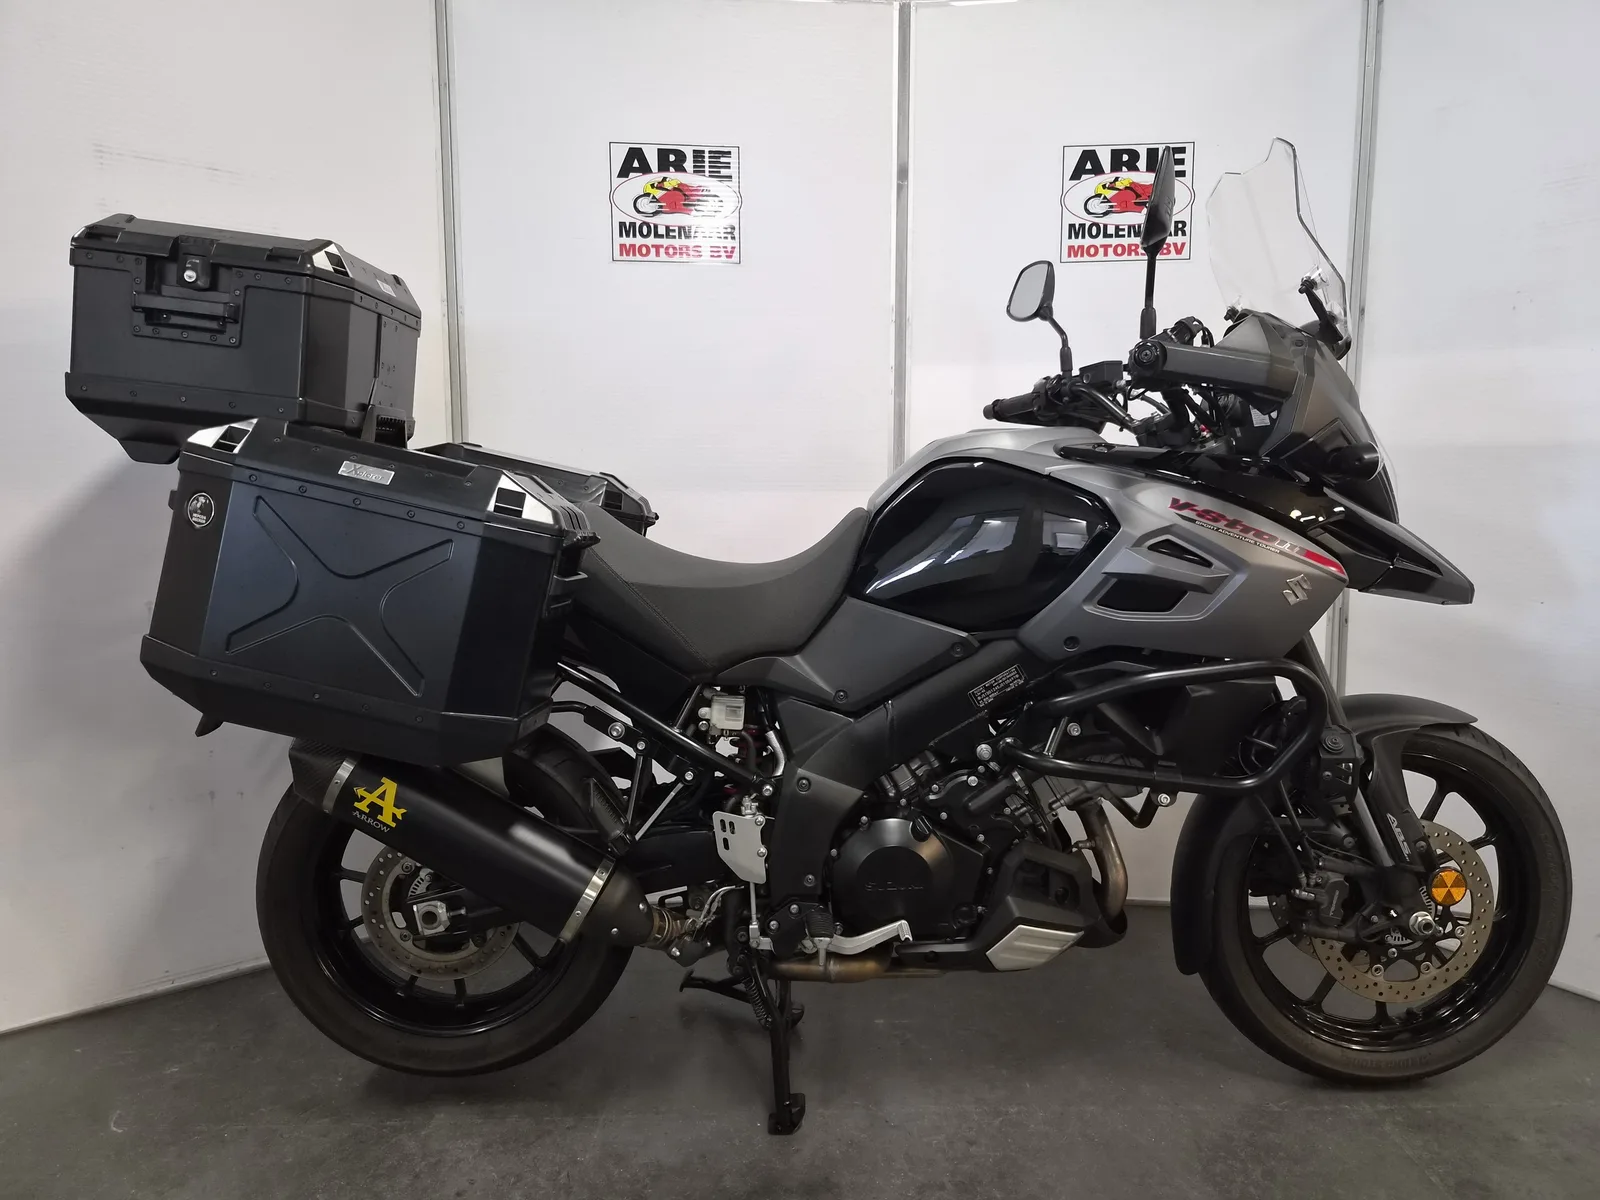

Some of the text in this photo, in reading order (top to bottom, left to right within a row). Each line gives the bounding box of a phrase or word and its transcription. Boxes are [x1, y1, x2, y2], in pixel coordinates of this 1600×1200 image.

[617, 147, 732, 181] ARIE
[1069, 146, 1186, 180] ARIE
[1068, 220, 1187, 239] MOLENR
[619, 243, 702, 258] MOTORS
[1067, 242, 1186, 258] MOTOR BV
[1195, 520, 1280, 554] SPORT ADVENTURE TOURER
[352, 810, 390, 833] ARROW
